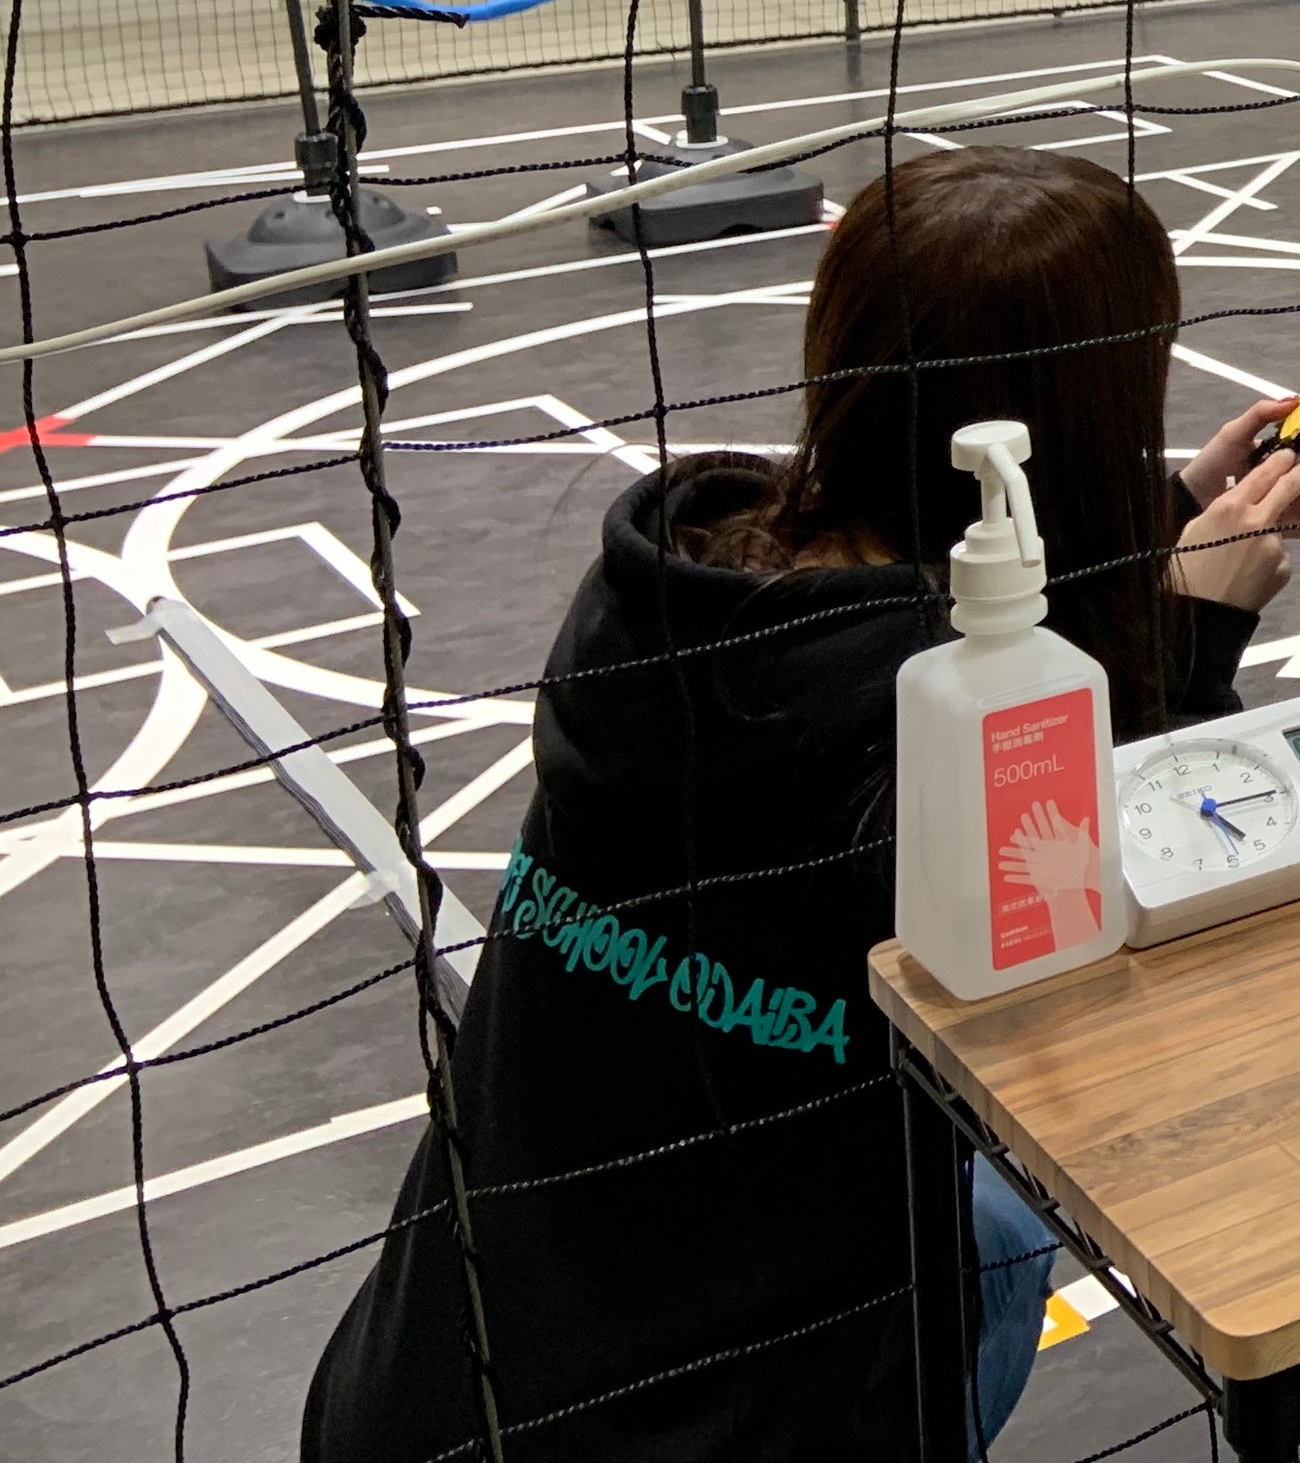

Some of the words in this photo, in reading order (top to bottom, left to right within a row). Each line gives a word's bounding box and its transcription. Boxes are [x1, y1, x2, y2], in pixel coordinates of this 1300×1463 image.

[991, 725, 1021, 743] Hand
[1022, 715, 1069, 734] Sanitizer
[993, 753, 1066, 788] 500mL
[1173, 764, 1191, 777] 12
[1240, 771, 1253, 784] 2
[1147, 779, 1163, 792] 11
[1134, 802, 1152, 816] 10
[1266, 816, 1278, 827] 4
[1139, 827, 1153, 840] 9
[1253, 839, 1266, 851] 5
